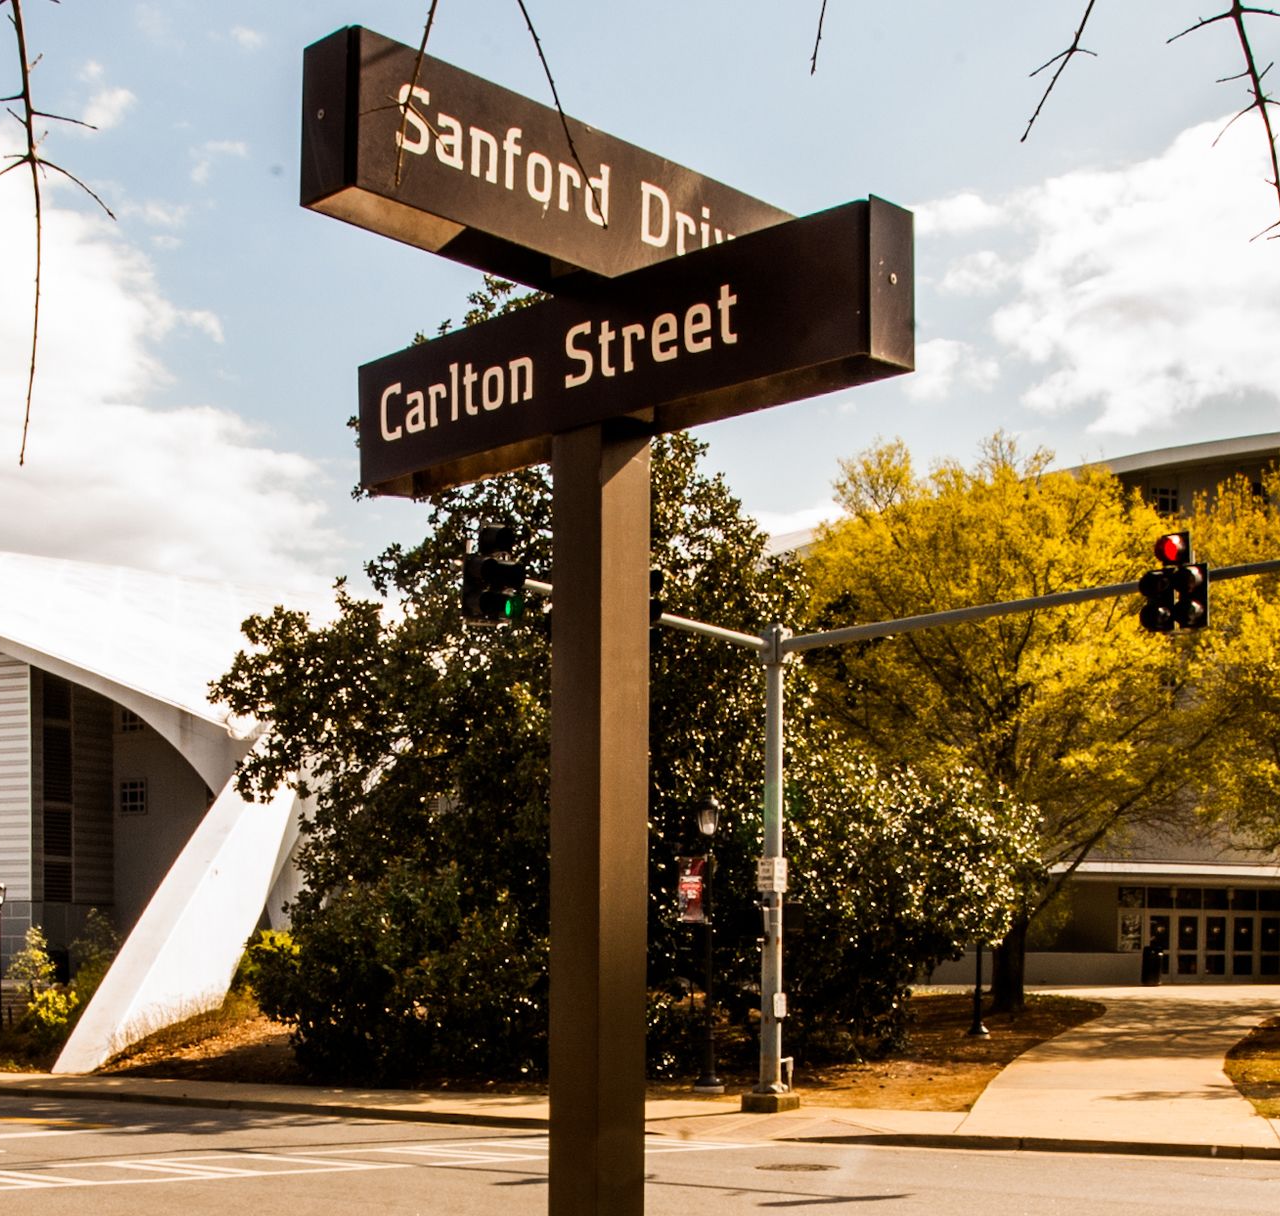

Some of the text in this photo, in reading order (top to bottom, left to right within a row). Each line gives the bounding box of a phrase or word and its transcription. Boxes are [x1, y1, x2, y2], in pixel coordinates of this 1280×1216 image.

[396, 83, 611, 227] Sanford
[379, 283, 739, 442] Carlton Street
